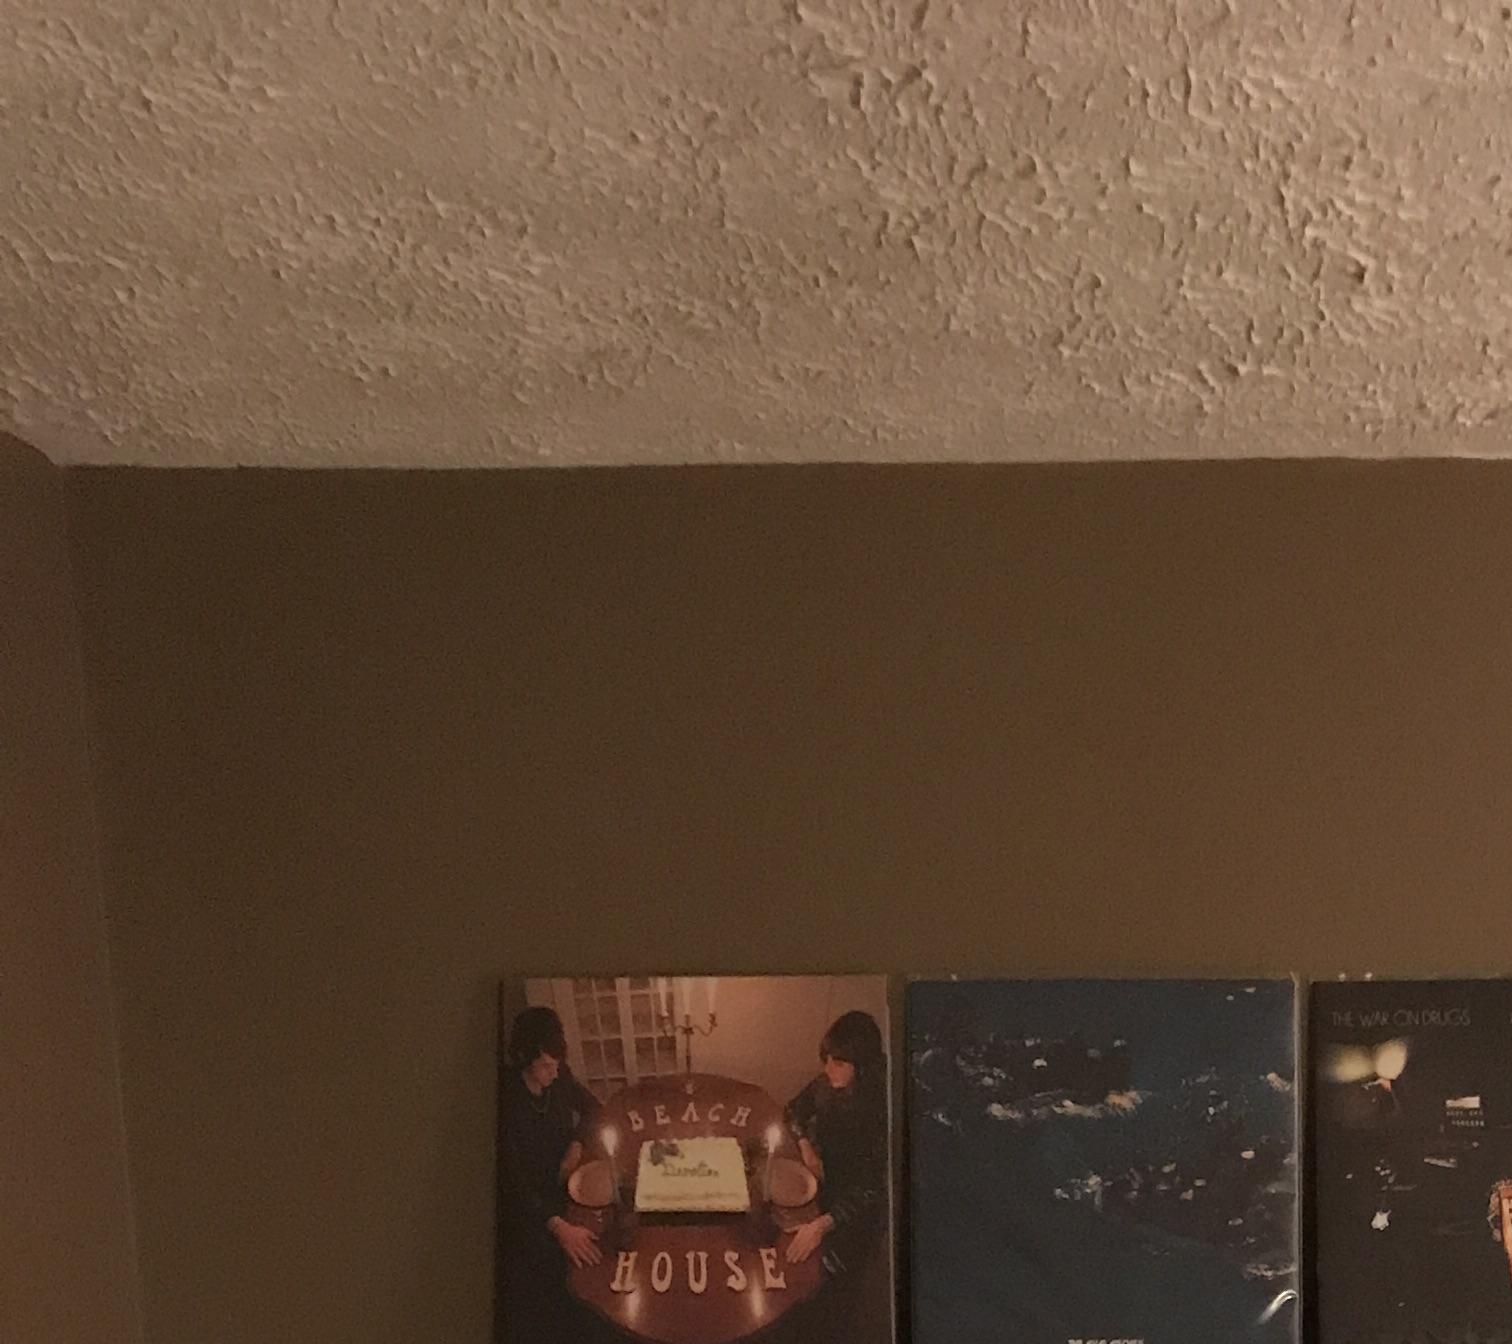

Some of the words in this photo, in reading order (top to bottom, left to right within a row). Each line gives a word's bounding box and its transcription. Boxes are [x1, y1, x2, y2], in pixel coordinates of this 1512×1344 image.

[1331, 1010, 1354, 1027] THE
[1359, 1009, 1389, 1027] WAR
[1393, 1008, 1420, 1026] ON
[1421, 1007, 1472, 1026] DRUGS
[627, 1102, 752, 1132] BEACH
[609, 1247, 788, 1294] HOUSE
